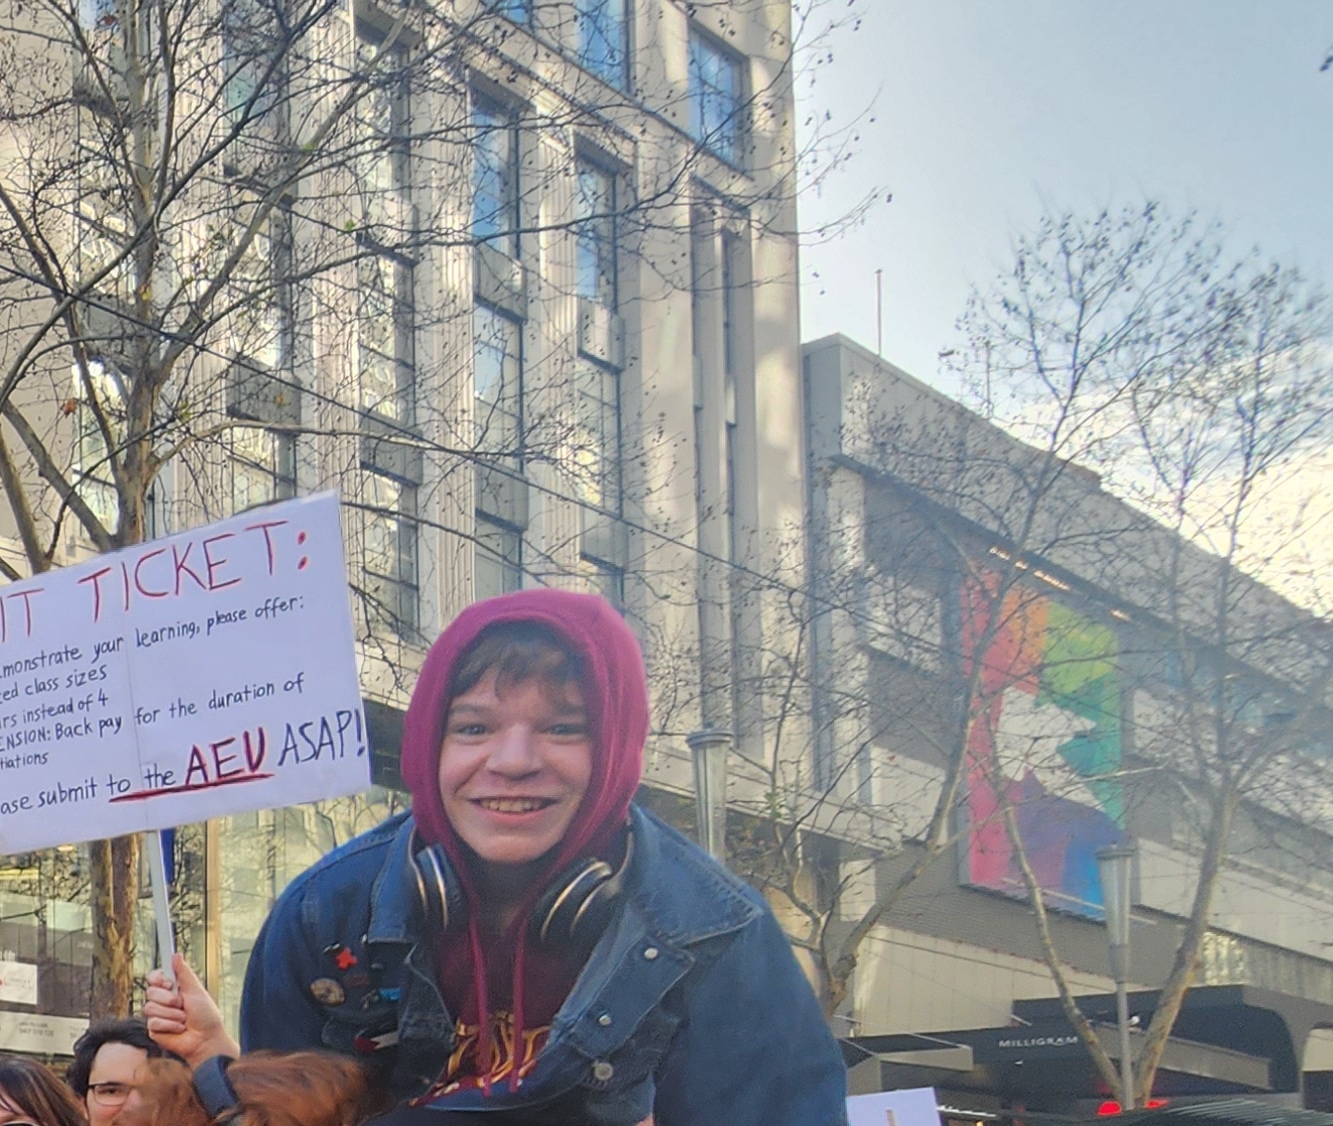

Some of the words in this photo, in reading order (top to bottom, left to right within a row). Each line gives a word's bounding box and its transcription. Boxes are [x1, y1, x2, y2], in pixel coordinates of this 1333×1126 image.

[77, 520, 307, 623] TICKET:
[93, 636, 125, 666] your
[136, 620, 201, 650] learning,
[207, 608, 248, 635] please
[254, 595, 305, 620] offer:
[22, 697, 74, 724] instead
[77, 693, 94, 714] of
[97, 691, 109, 708] 4
[25, 677, 59, 697] class
[66, 664, 109, 689] sizes
[55, 719, 94, 741] Back
[98, 715, 124, 740] pay
[135, 704, 161, 724] for
[169, 697, 199, 717] the
[208, 681, 276, 709] duration
[283, 672, 305, 696] of
[38, 777, 98, 808] submit
[106, 773, 131, 795] to
[143, 765, 177, 789] the
[184, 726, 267, 787] AEU
[277, 709, 367, 767] ASAP!
[999, 1036, 1079, 1049] MILLIGRAM
